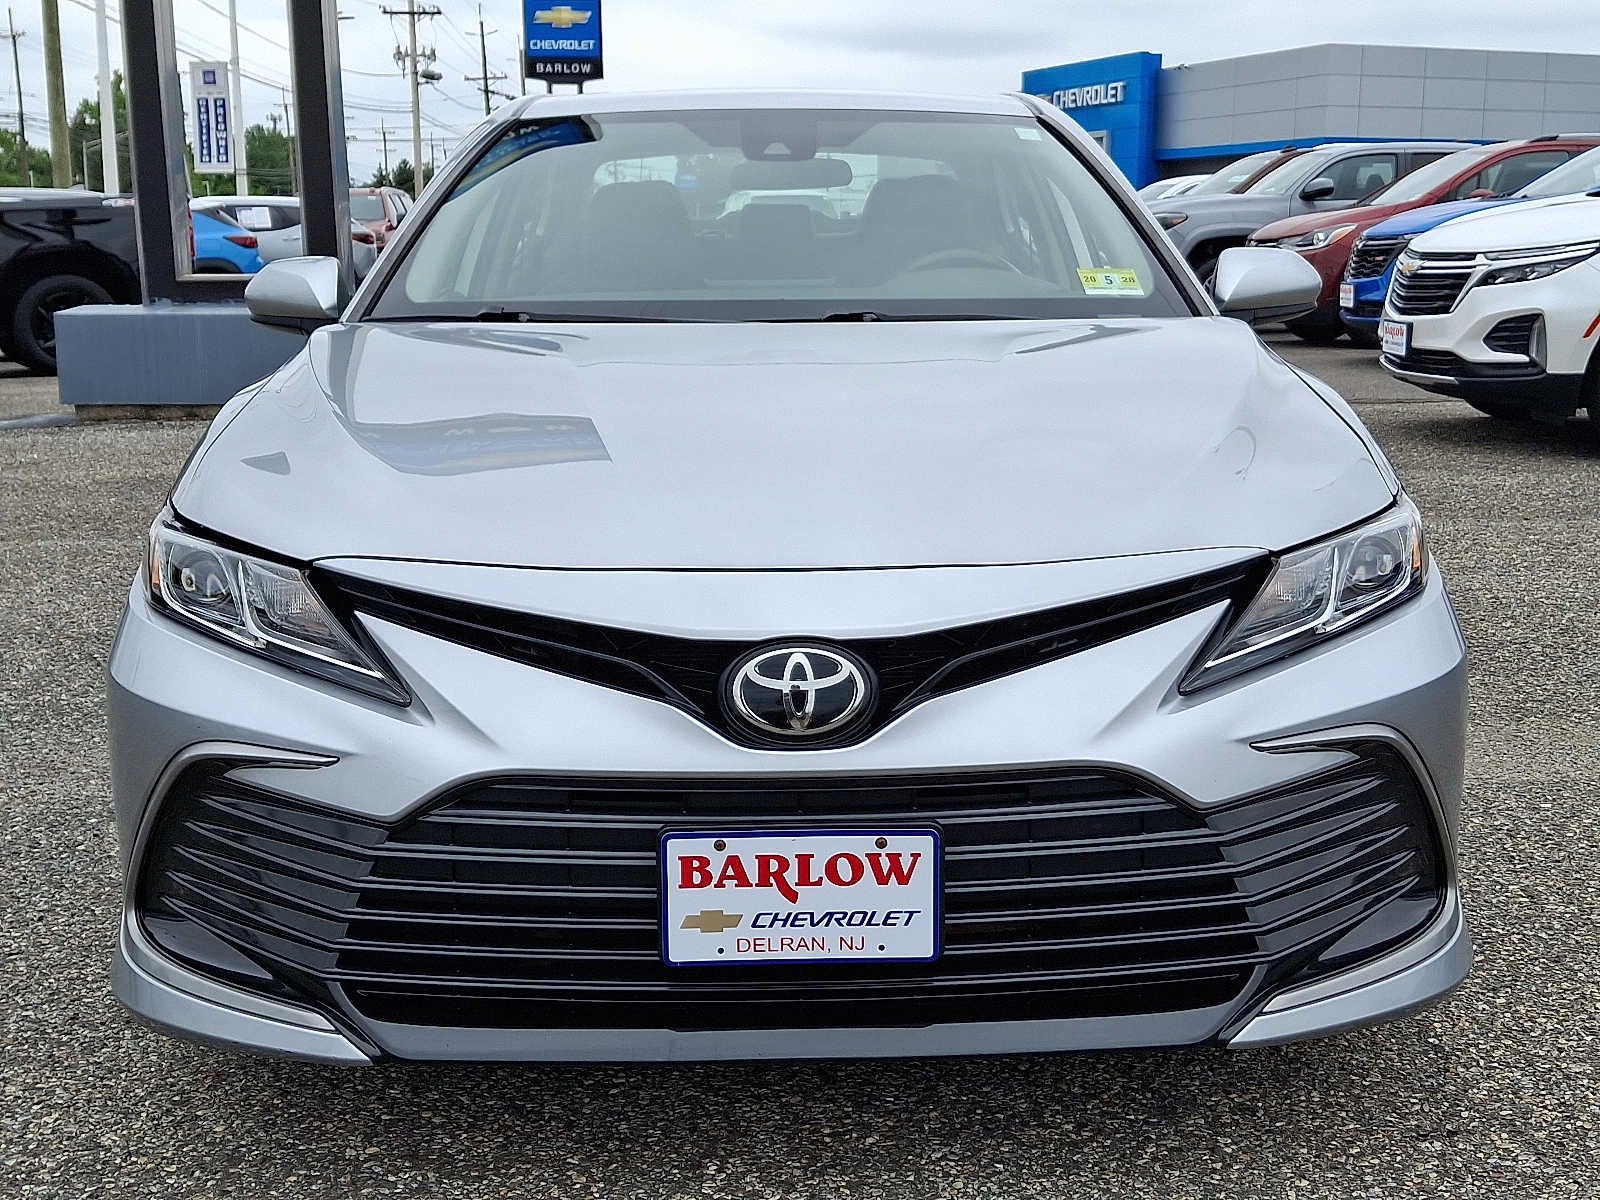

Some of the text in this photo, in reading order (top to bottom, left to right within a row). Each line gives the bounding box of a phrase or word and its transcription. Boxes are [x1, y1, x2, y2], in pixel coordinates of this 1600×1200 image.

[529, 39, 595, 50] CHEVROLET
[536, 62, 591, 74] BARLOW
[1052, 81, 1125, 110] CHEVROLET
[1104, 275, 1113, 285] 5
[677, 851, 922, 904] BARLOW
[750, 910, 922, 929] CHEVROLET
[736, 936, 865, 953] DELRAN, NJ
